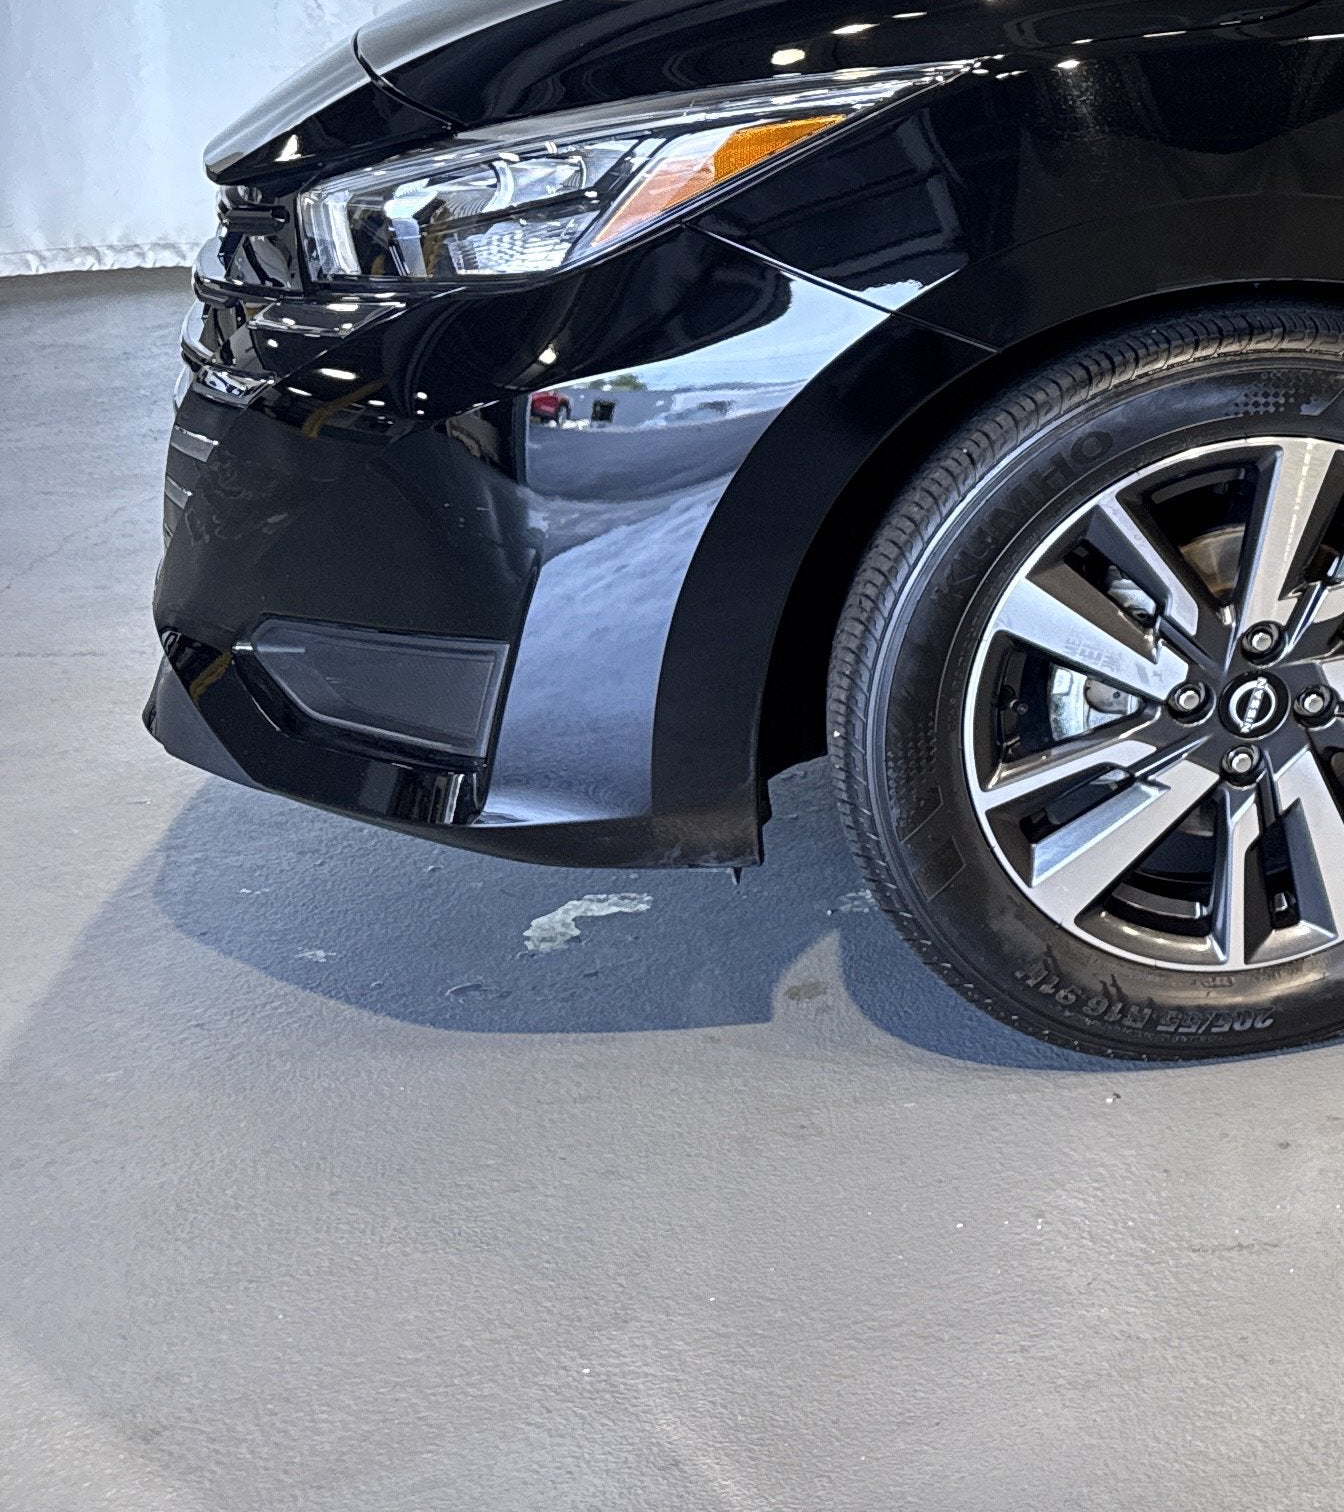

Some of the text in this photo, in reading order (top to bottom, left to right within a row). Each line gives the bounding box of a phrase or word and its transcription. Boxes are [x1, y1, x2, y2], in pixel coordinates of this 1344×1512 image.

[931, 430, 1113, 601] KUMHO
[1239, 676, 1268, 734] NISSAN
[1156, 1003, 1276, 1035] 205/55
